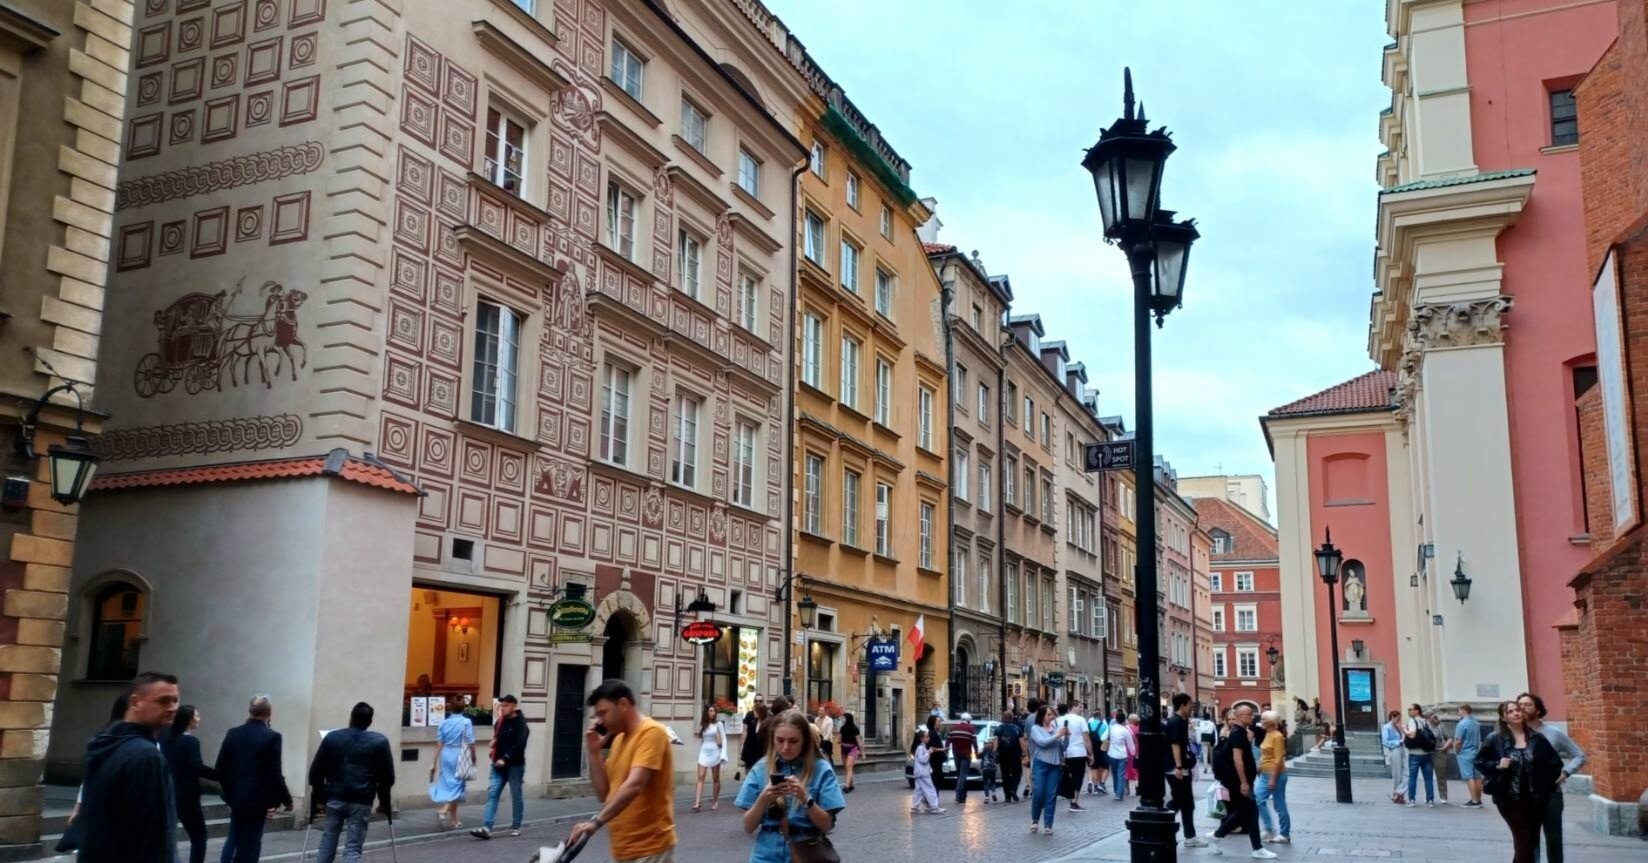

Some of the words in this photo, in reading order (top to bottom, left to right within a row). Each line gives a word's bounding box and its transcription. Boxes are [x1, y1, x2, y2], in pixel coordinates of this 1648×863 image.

[1113, 446, 1127, 454] HOT
[1112, 455, 1129, 463] SPOT
[871, 645, 895, 654] ATM
